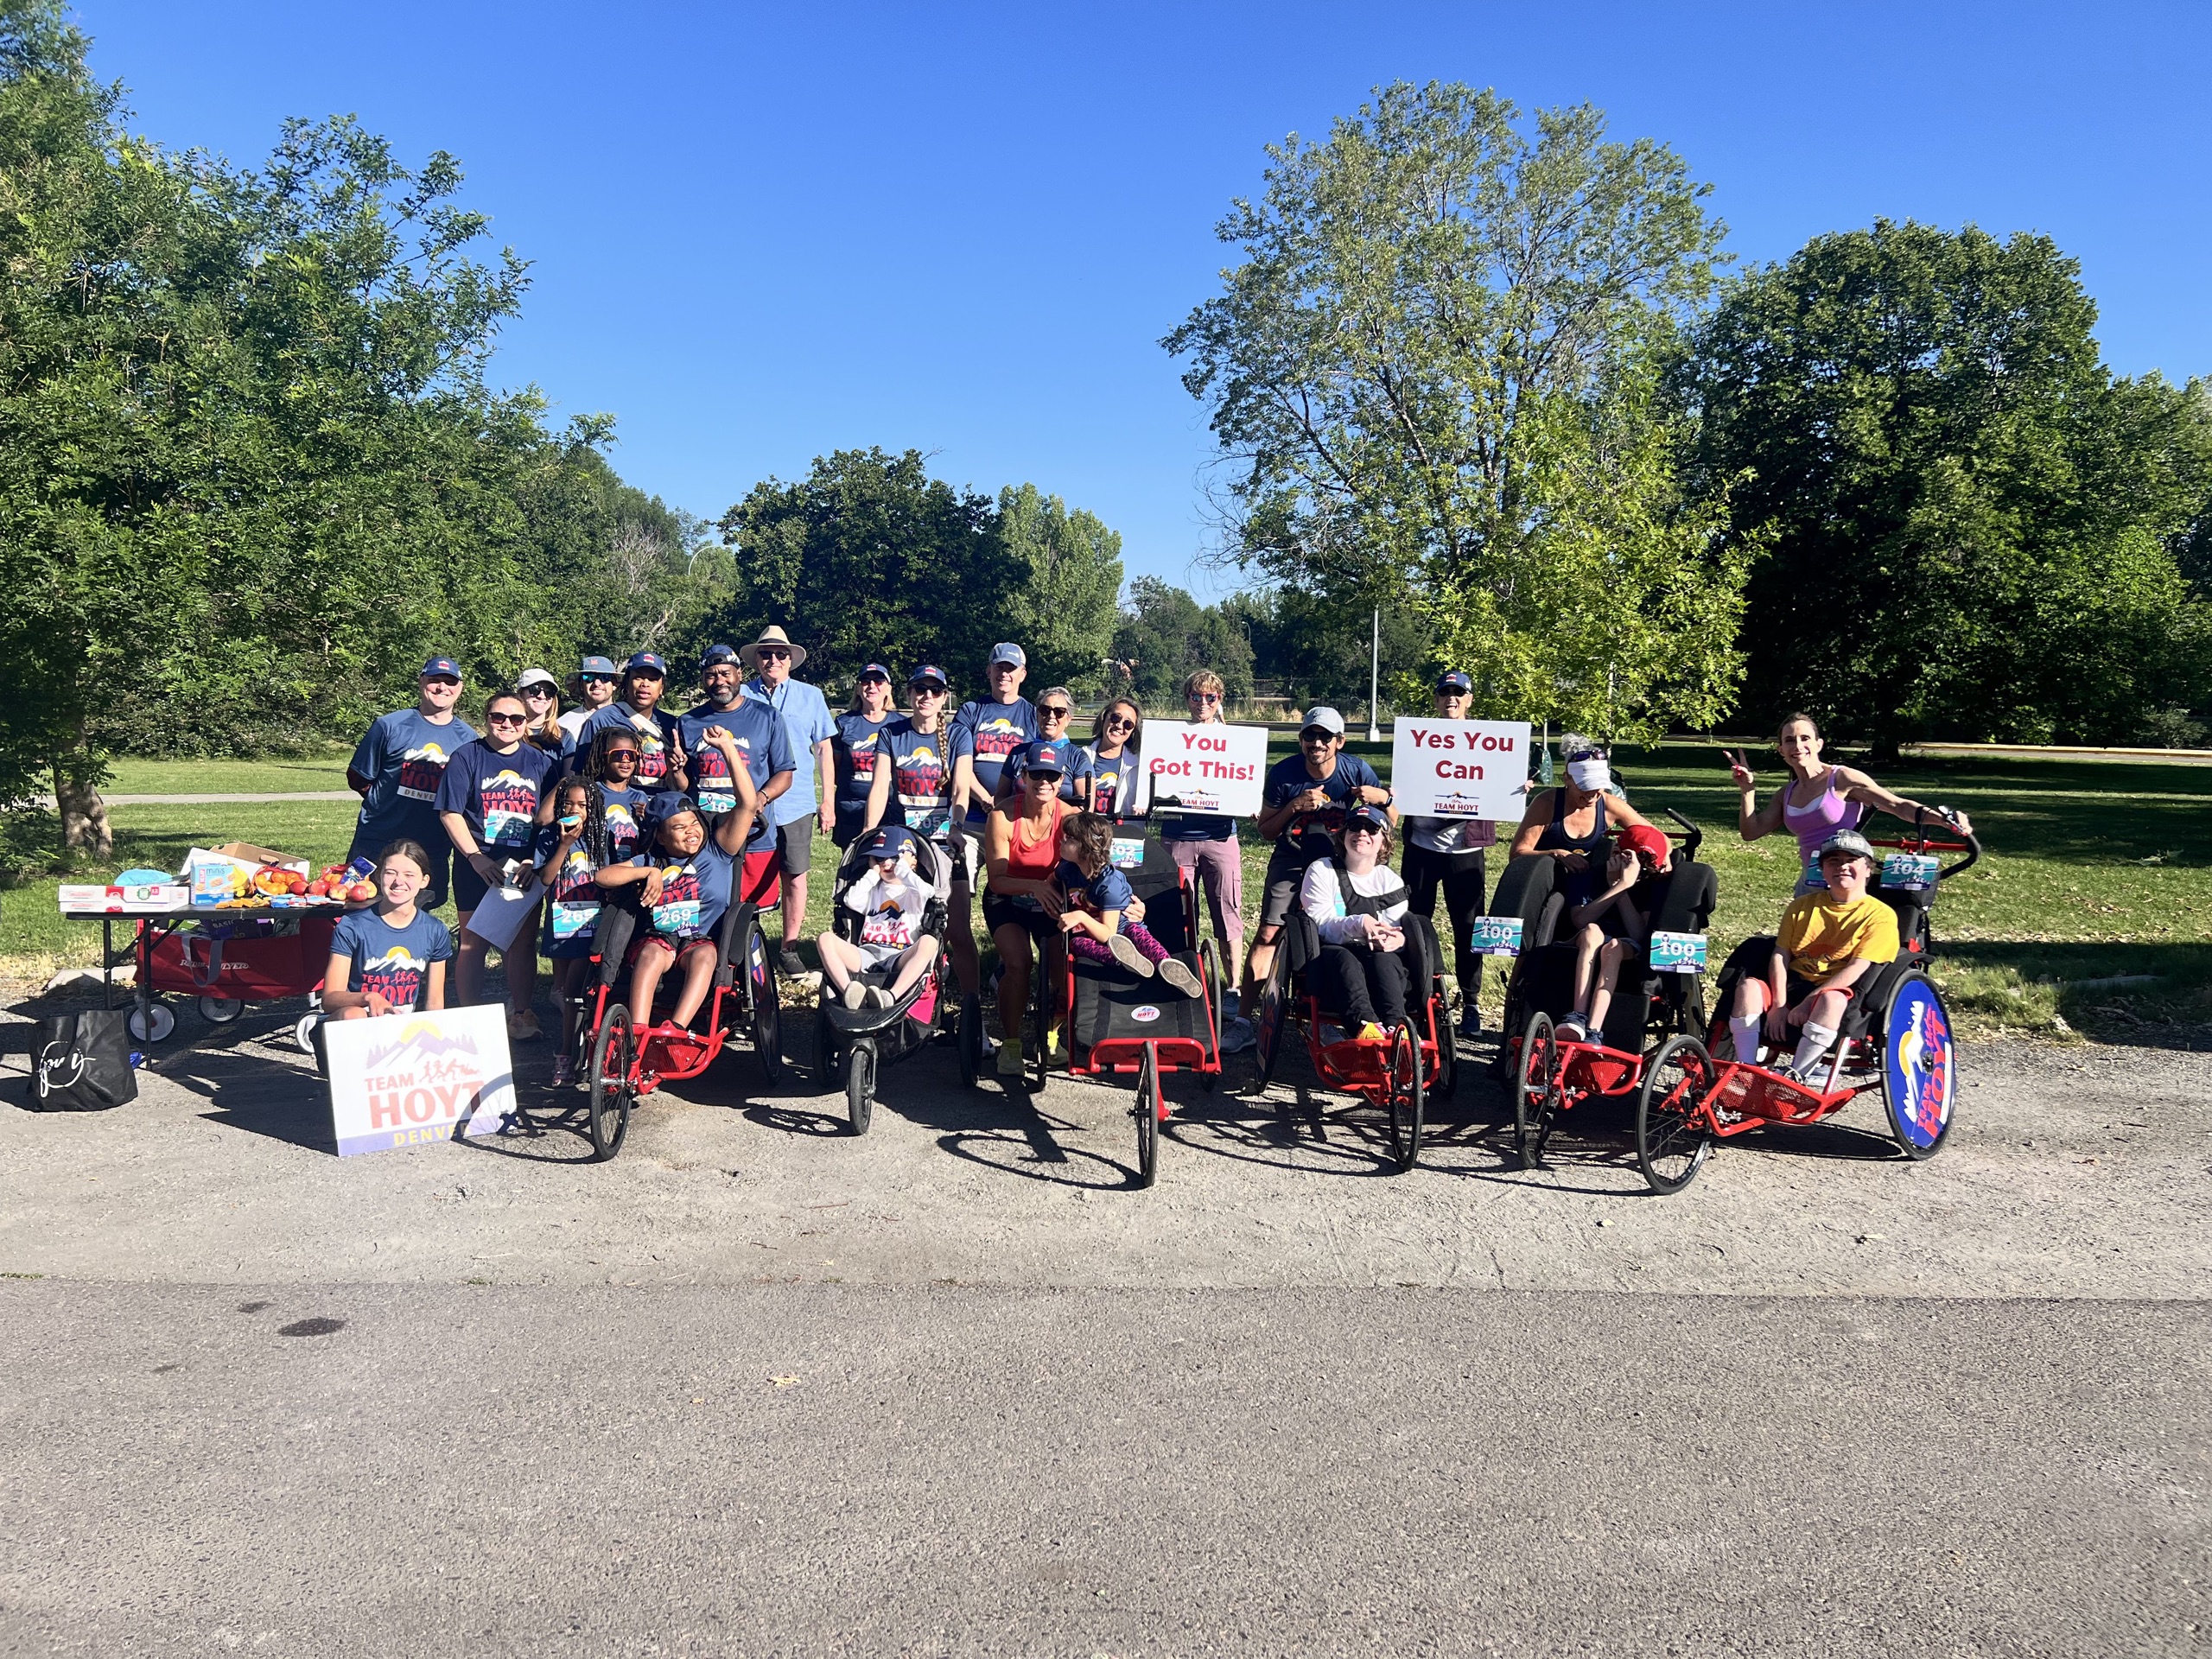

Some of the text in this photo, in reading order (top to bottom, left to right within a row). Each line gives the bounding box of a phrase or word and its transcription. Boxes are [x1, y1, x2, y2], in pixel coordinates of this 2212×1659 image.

[1181, 733, 1227, 752] You
[1410, 729, 1514, 752] Yes You
[1149, 758, 1255, 781] Got This!
[1435, 760, 1484, 780] Can
[400, 769, 441, 792] HOY
[898, 778, 939, 796] HOY
[404, 789, 435, 801] DENVE
[480, 791, 506, 800] TEAM
[1891, 863, 1925, 876] 104
[658, 882, 701, 906] OYT
[562, 910, 594, 924] 265
[661, 908, 691, 925] 269
[1480, 925, 1513, 940] 100
[1659, 942, 1696, 957] 100
[362, 974, 390, 984] TEAM
[364, 1072, 415, 1092] TEAM
[1923, 1010, 1947, 1139] HOYT
[368, 1080, 485, 1129] HOYT
[1917, 1082, 1932, 1128] TEAM
